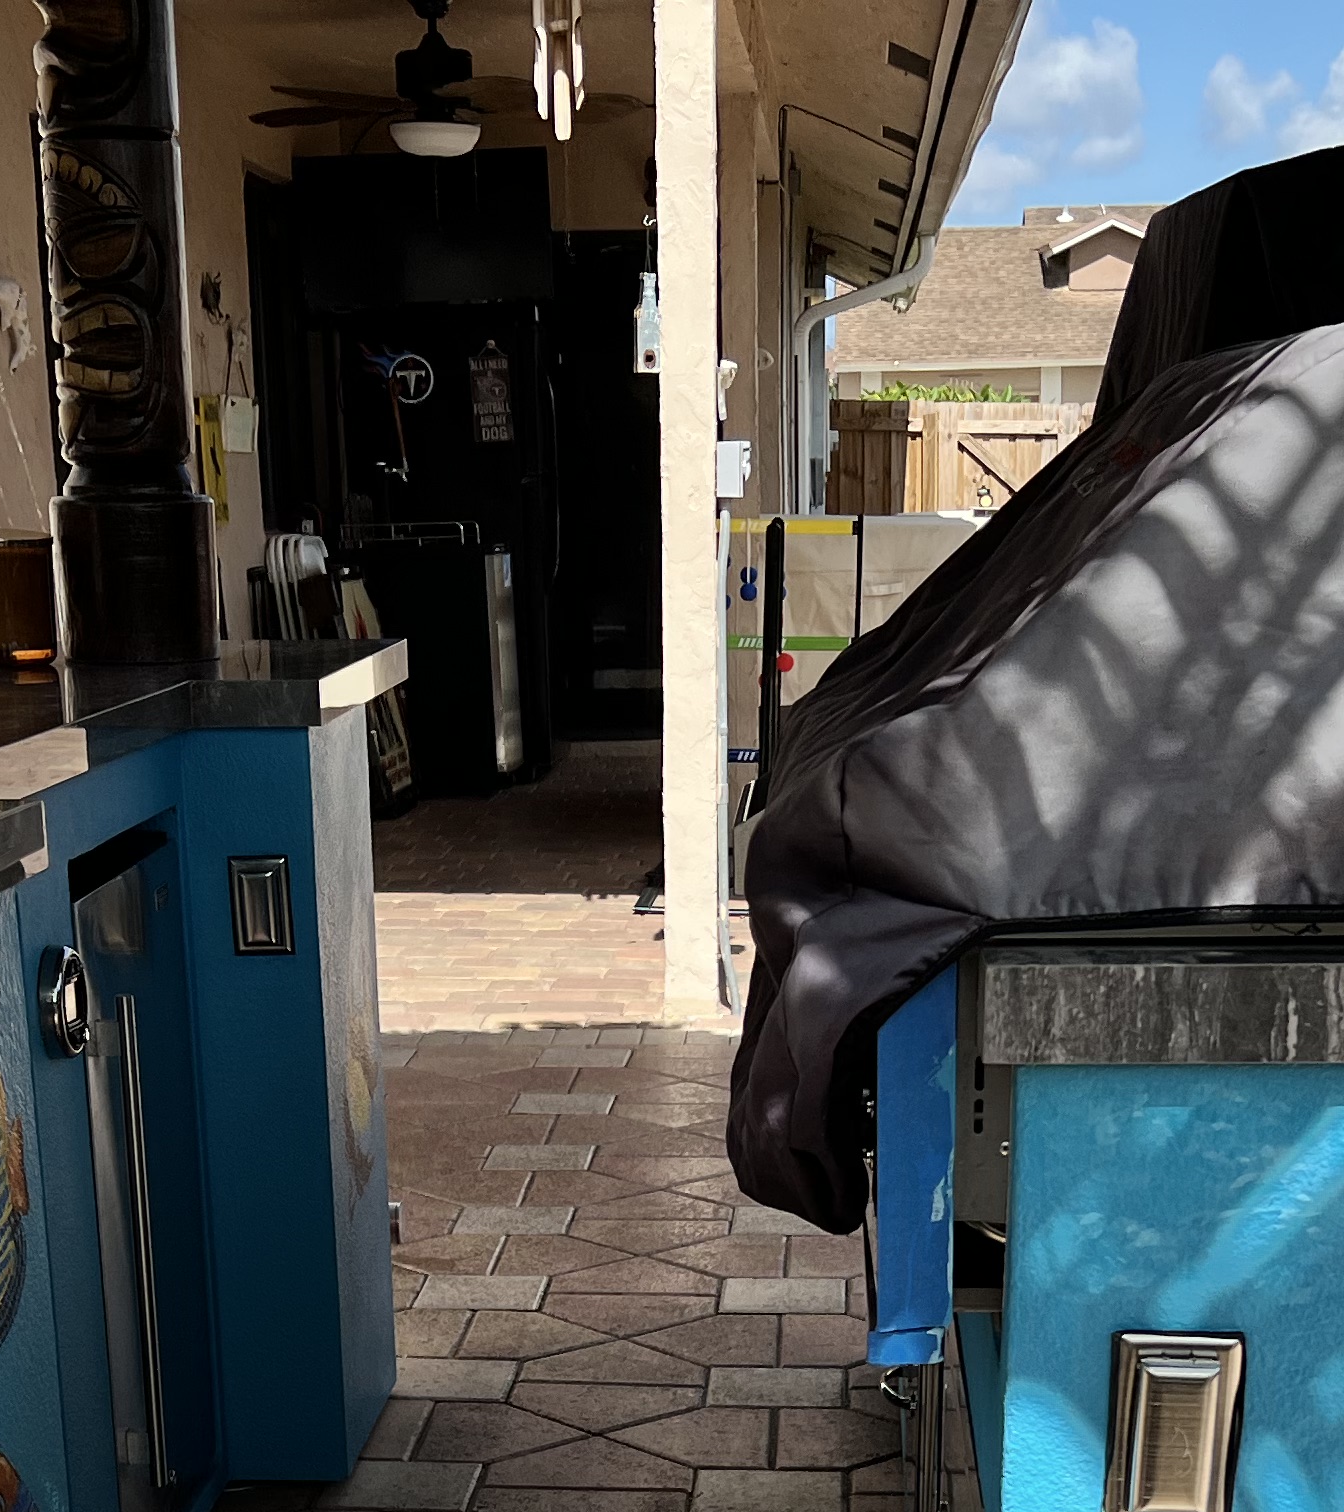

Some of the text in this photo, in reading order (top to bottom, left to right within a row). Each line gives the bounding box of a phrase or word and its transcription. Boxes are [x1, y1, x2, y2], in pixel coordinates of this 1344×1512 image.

[474, 402, 511, 415] FOOTBALL
[480, 414, 506, 425] AND MY
[482, 426, 508, 441] DOG
